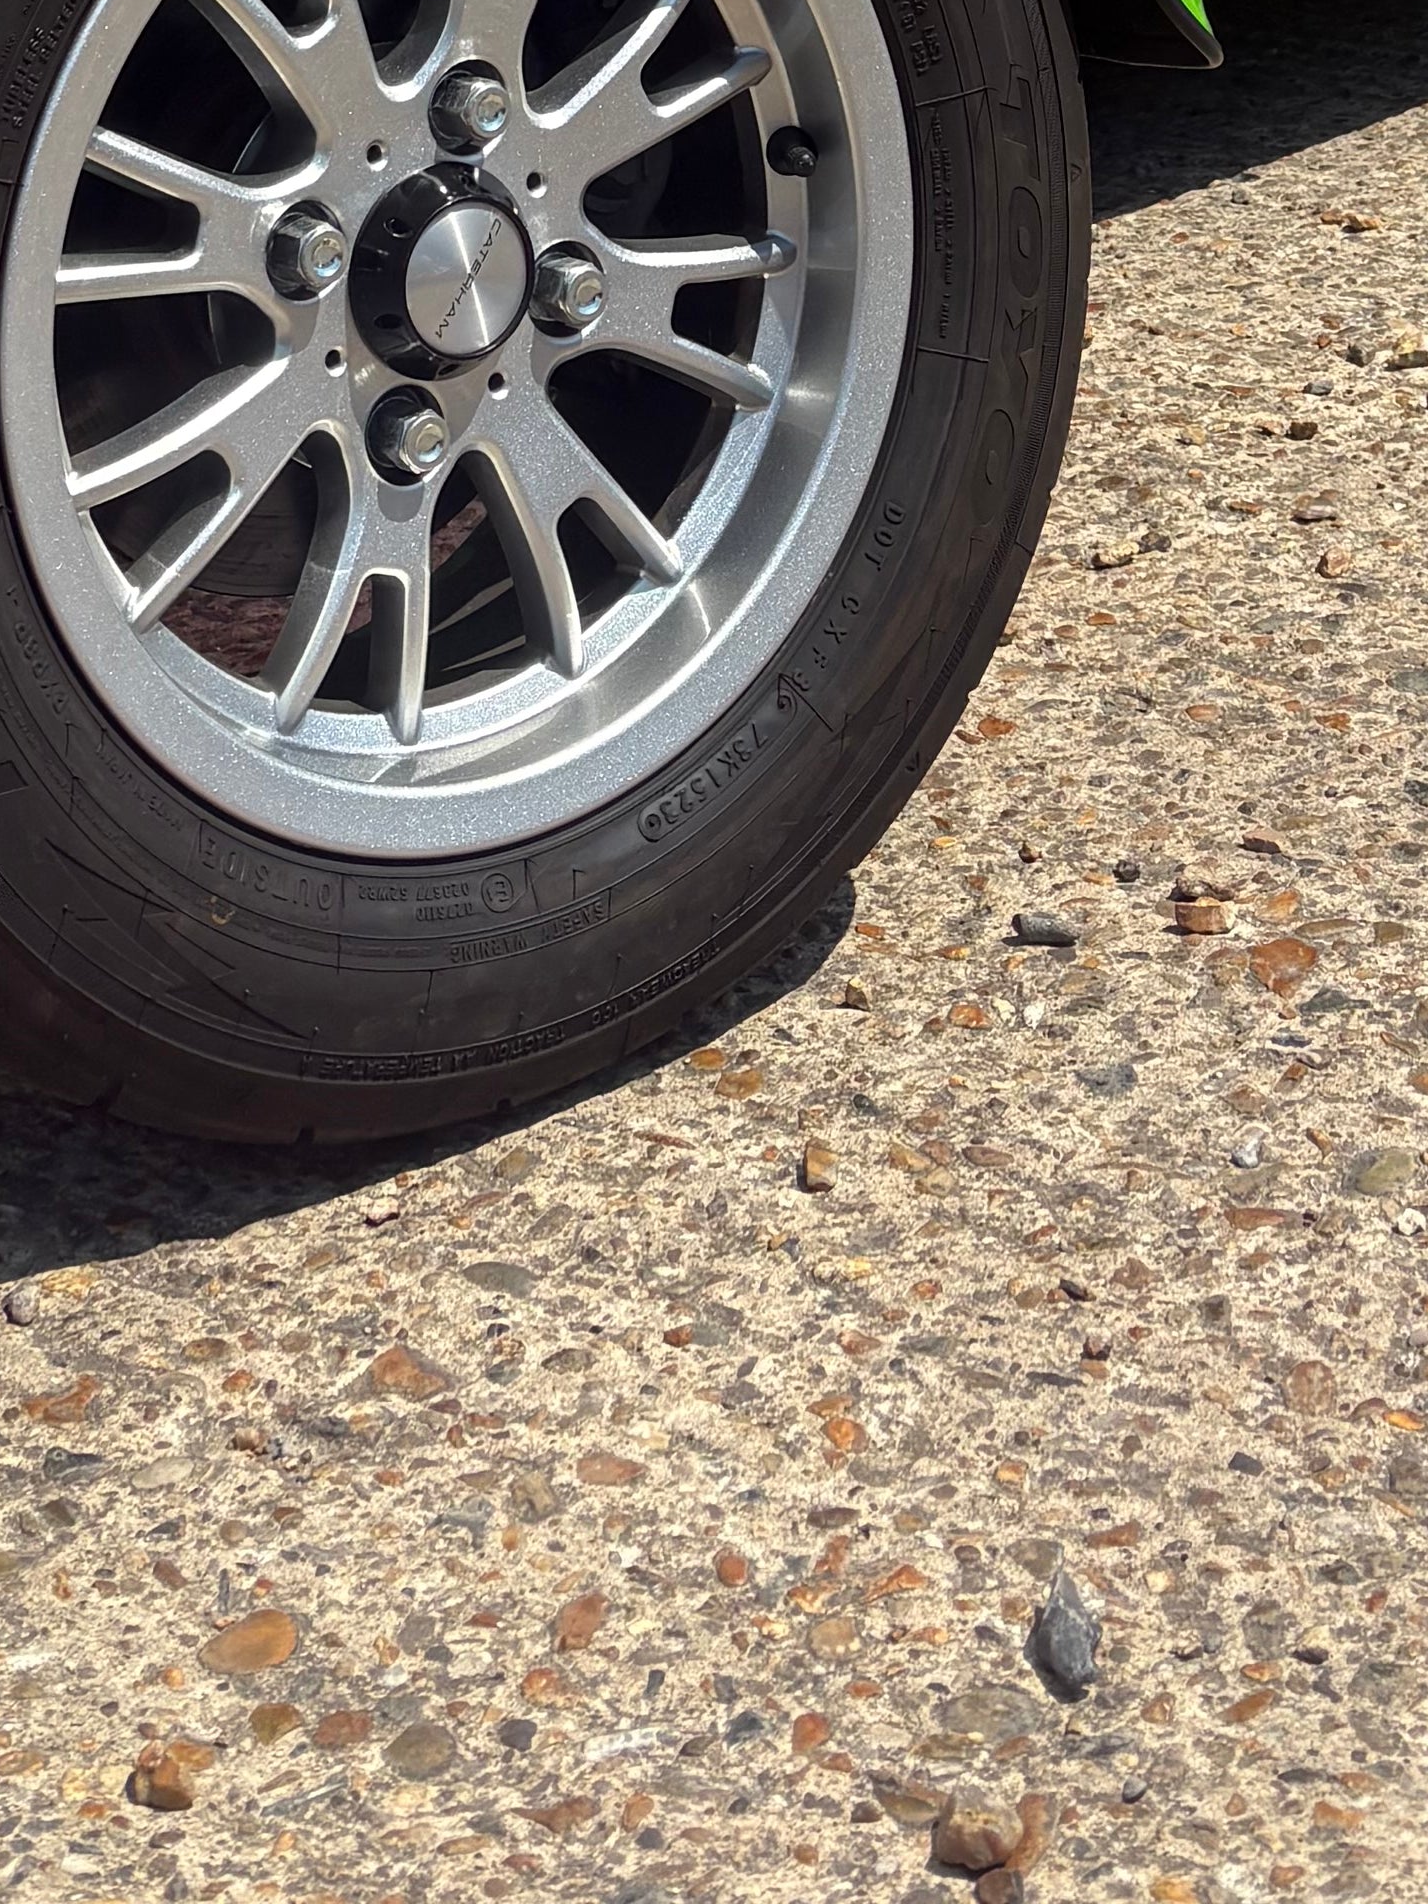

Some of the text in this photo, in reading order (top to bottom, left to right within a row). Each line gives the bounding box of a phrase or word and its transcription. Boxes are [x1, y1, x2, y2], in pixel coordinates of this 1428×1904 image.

[435, 218, 503, 339] CATERHAM
[968, 72, 1046, 528] TOYO
[862, 502, 905, 574] DOT
[200, 840, 332, 910] OUTSIDE
[451, 933, 528, 964] WARNING
